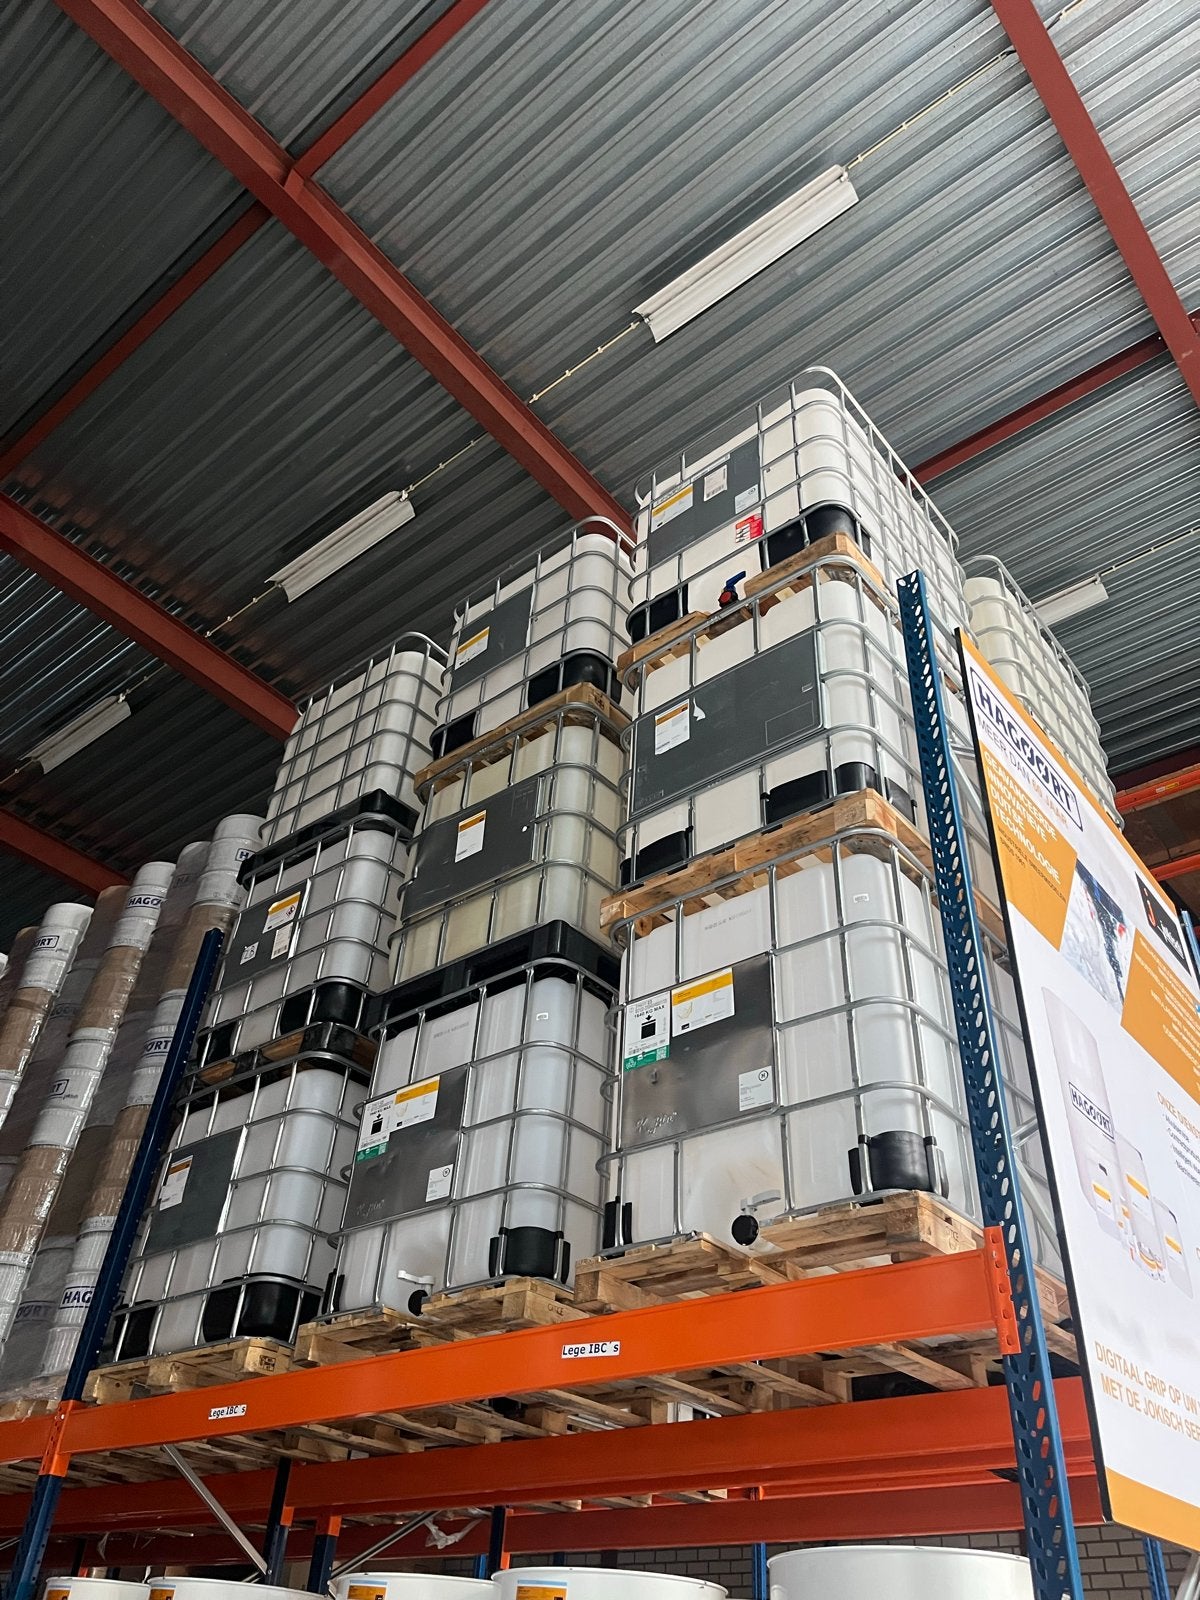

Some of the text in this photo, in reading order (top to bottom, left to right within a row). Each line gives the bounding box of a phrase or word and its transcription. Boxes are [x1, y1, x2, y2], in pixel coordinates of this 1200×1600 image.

[977, 683, 1072, 812] HAGOORT
[977, 713, 1008, 757] MEER
[1010, 752, 1031, 784] DAN
[983, 751, 1057, 841] GEAVANCEERDE
[987, 767, 1048, 842] INNOVATIEVE
[989, 783, 1025, 832] DUITSE
[993, 801, 1061, 885] TECHNOLOGIE
[562, 1345, 586, 1358] Lege
[1094, 1340, 1198, 1416] DIGITAAL GRIP OP UW
[209, 1409, 225, 1419] Lege
[1100, 1372, 1124, 1403] MET
[1125, 1386, 1142, 1413] DE
[1143, 1396, 1185, 1435] JOKISCH
